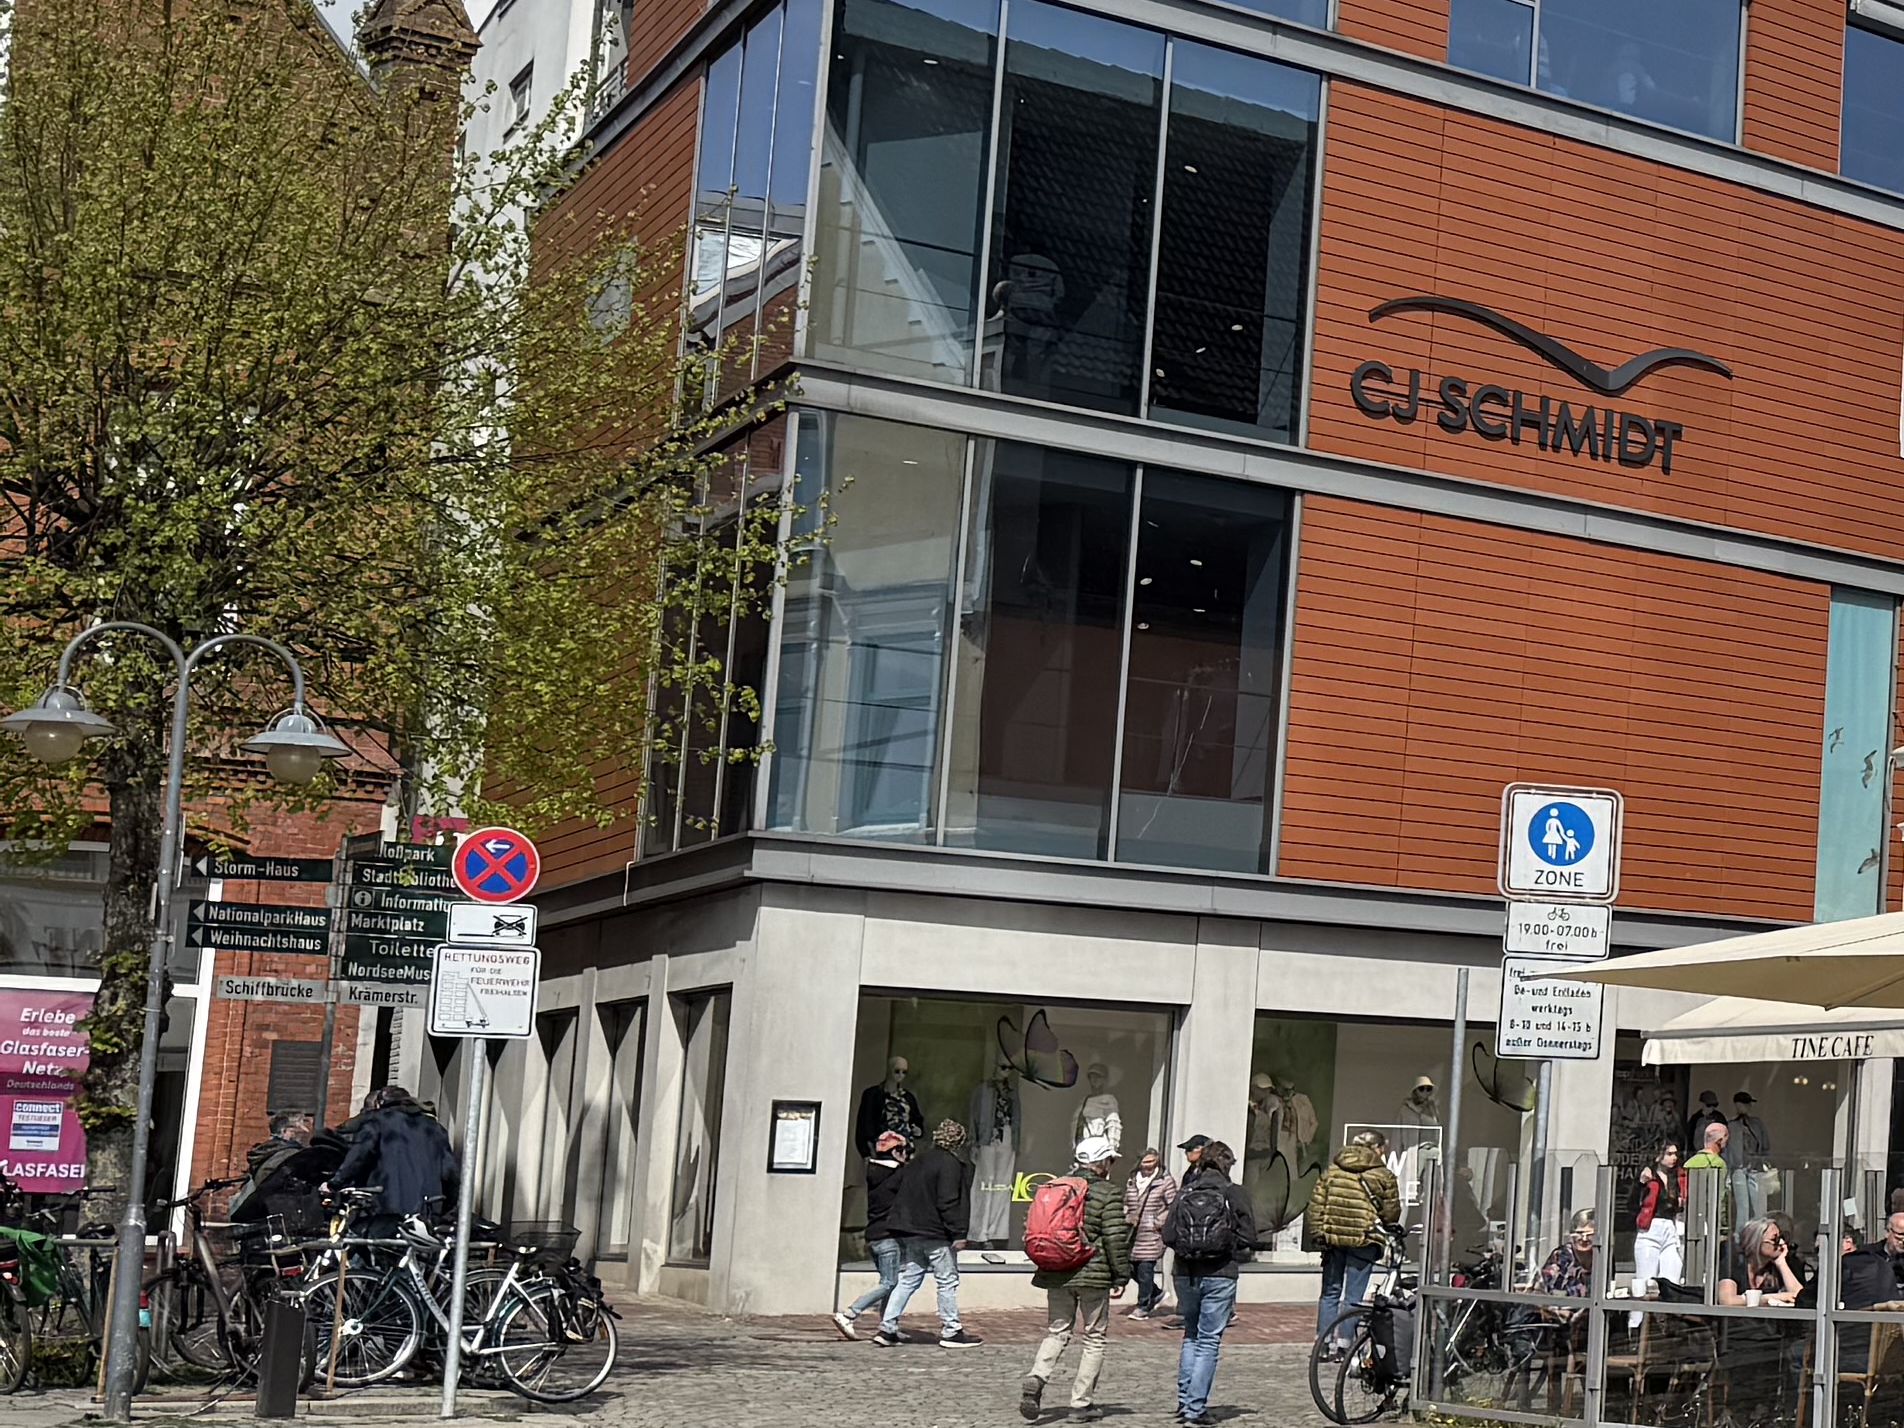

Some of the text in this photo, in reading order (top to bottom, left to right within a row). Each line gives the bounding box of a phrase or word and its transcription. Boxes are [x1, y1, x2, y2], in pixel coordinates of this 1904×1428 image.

[1350, 360, 1683, 475] CJ SCHMIDT
[214, 861, 300, 877] Storm-Haus
[1534, 869, 1585, 888] ZONE
[208, 906, 327, 927] NationalparkHaus
[351, 913, 425, 933] Marktplatz
[210, 929, 322, 951] Weihnachtshaus
[1545, 939, 1568, 951] frei
[348, 961, 431, 980] NordseeMus
[225, 979, 313, 998] Schiffbrücke
[348, 986, 419, 1005] Krämerstr.
[20, 1007, 76, 1024] Erlebe
[0, 1040, 90, 1057] Glasfaser-
[1791, 1035, 1875, 1059] TINE CAFE
[6, 1078, 75, 1091] Deutschlands
